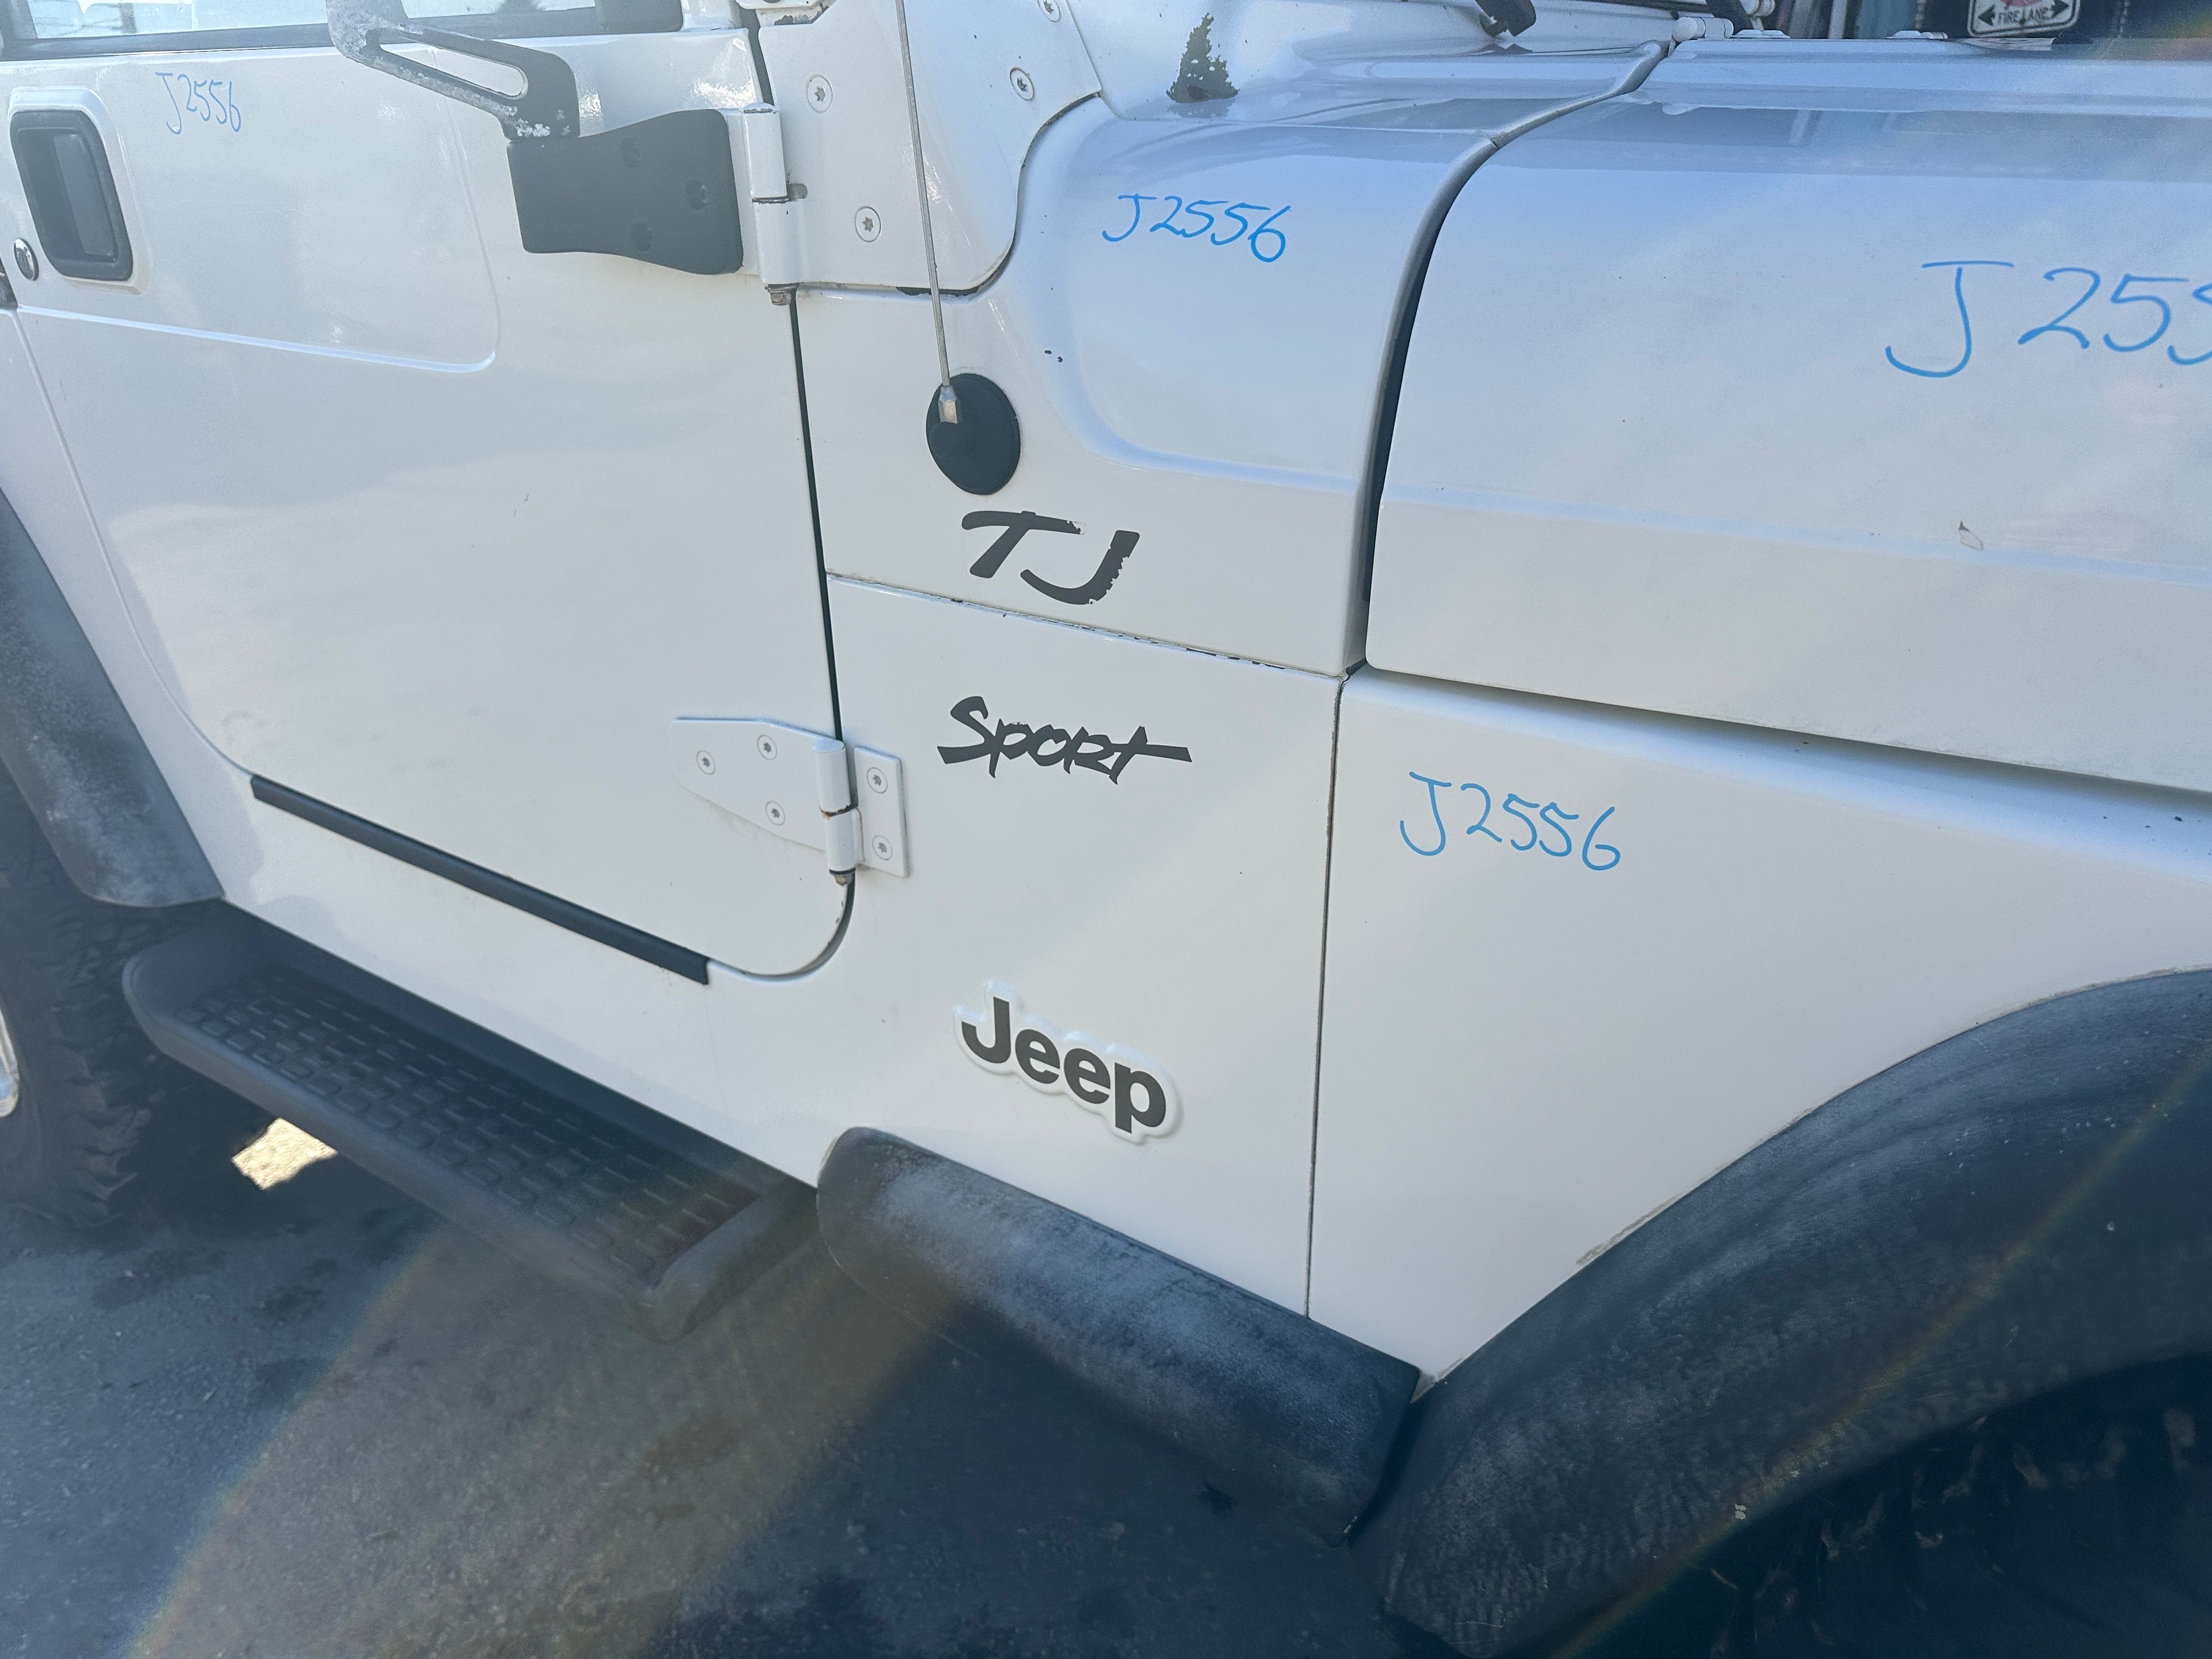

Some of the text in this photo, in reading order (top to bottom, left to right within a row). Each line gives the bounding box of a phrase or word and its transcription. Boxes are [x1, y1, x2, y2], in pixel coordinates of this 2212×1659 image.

[1998, 6, 2051, 24] FIRE LANE
[154, 71, 241, 135] J2556
[1101, 193, 1291, 263] J2556
[961, 510, 1140, 605] TJ
[1400, 771, 1620, 871] J2556
[961, 996, 1166, 1134] Jeep
